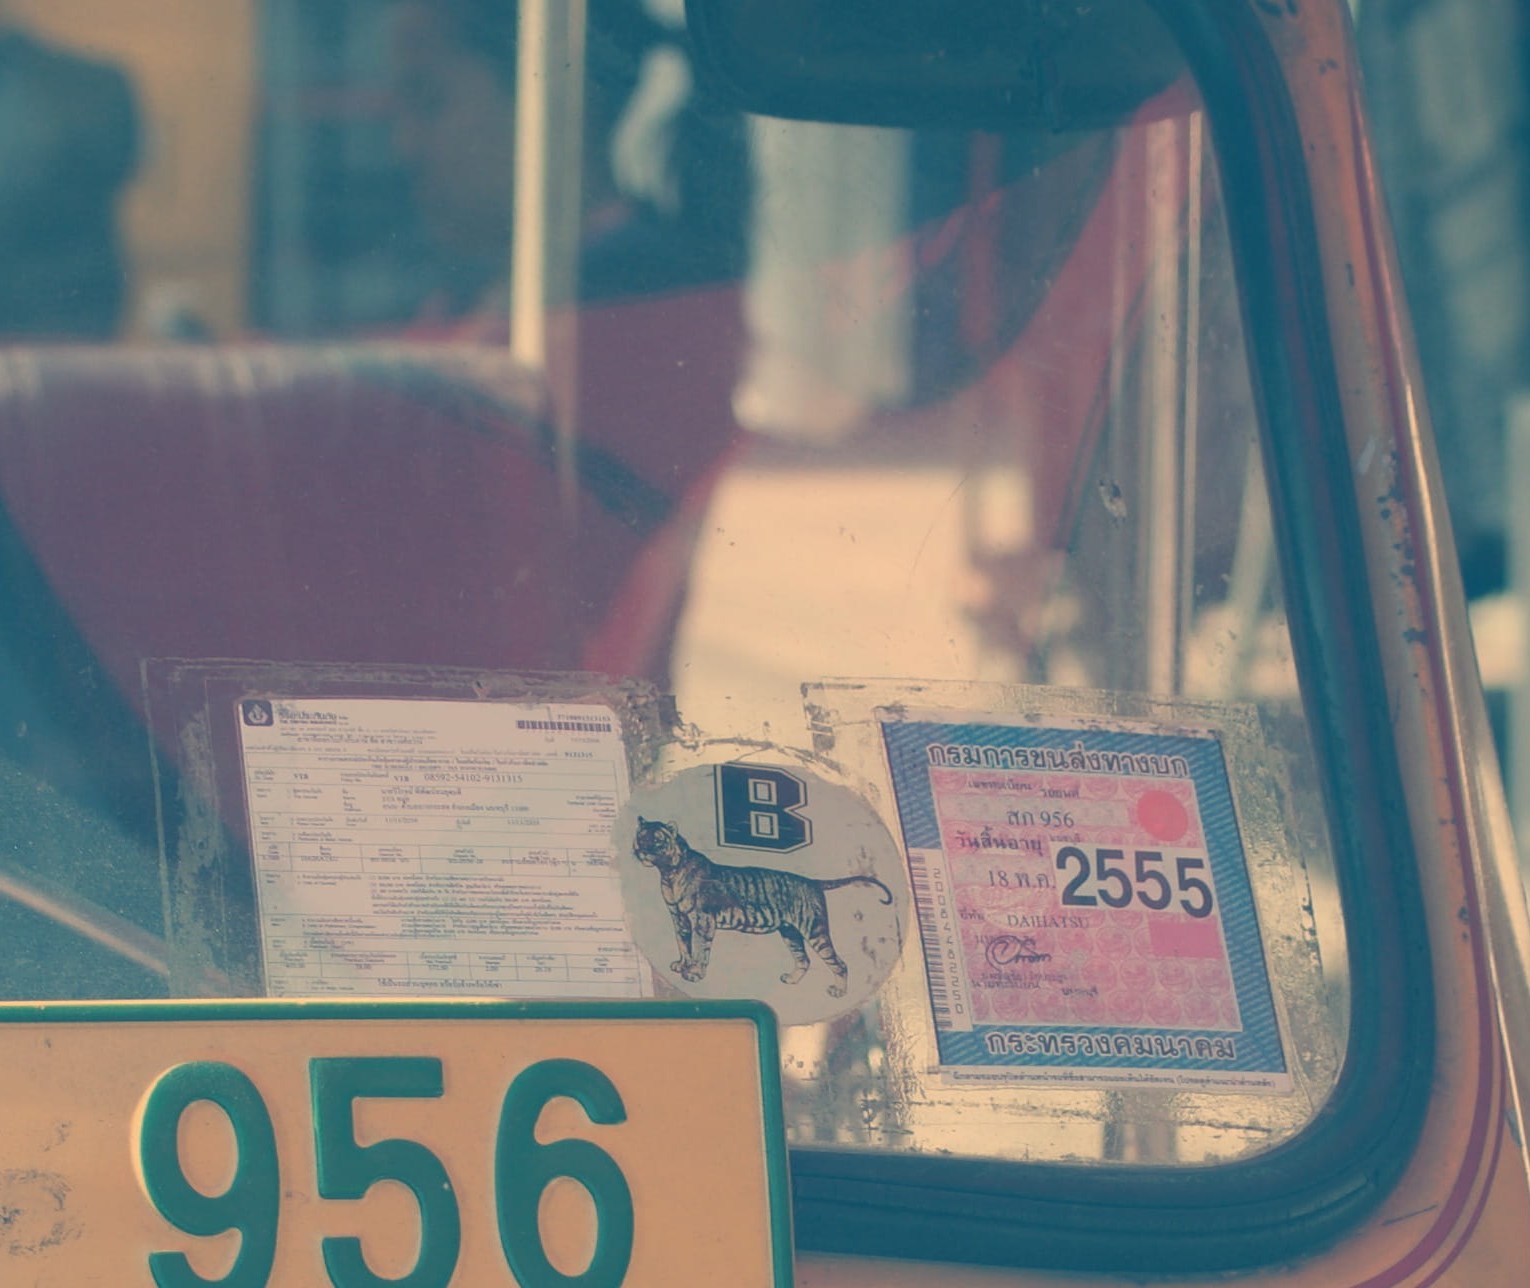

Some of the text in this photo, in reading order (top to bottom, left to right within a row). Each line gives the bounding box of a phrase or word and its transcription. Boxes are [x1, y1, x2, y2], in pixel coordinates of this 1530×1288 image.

[926, 740, 1189, 779] กรมการขนส่งทางบก
[714, 761, 813, 854] B
[1006, 807, 1075, 829] สก 956
[955, 826, 1043, 857] วันสิ้นอายุ
[1056, 846, 1214, 919] 2555
[1006, 913, 1089, 930] DAIHATSU
[986, 1030, 1236, 1060] กระทรวงคมนาคม
